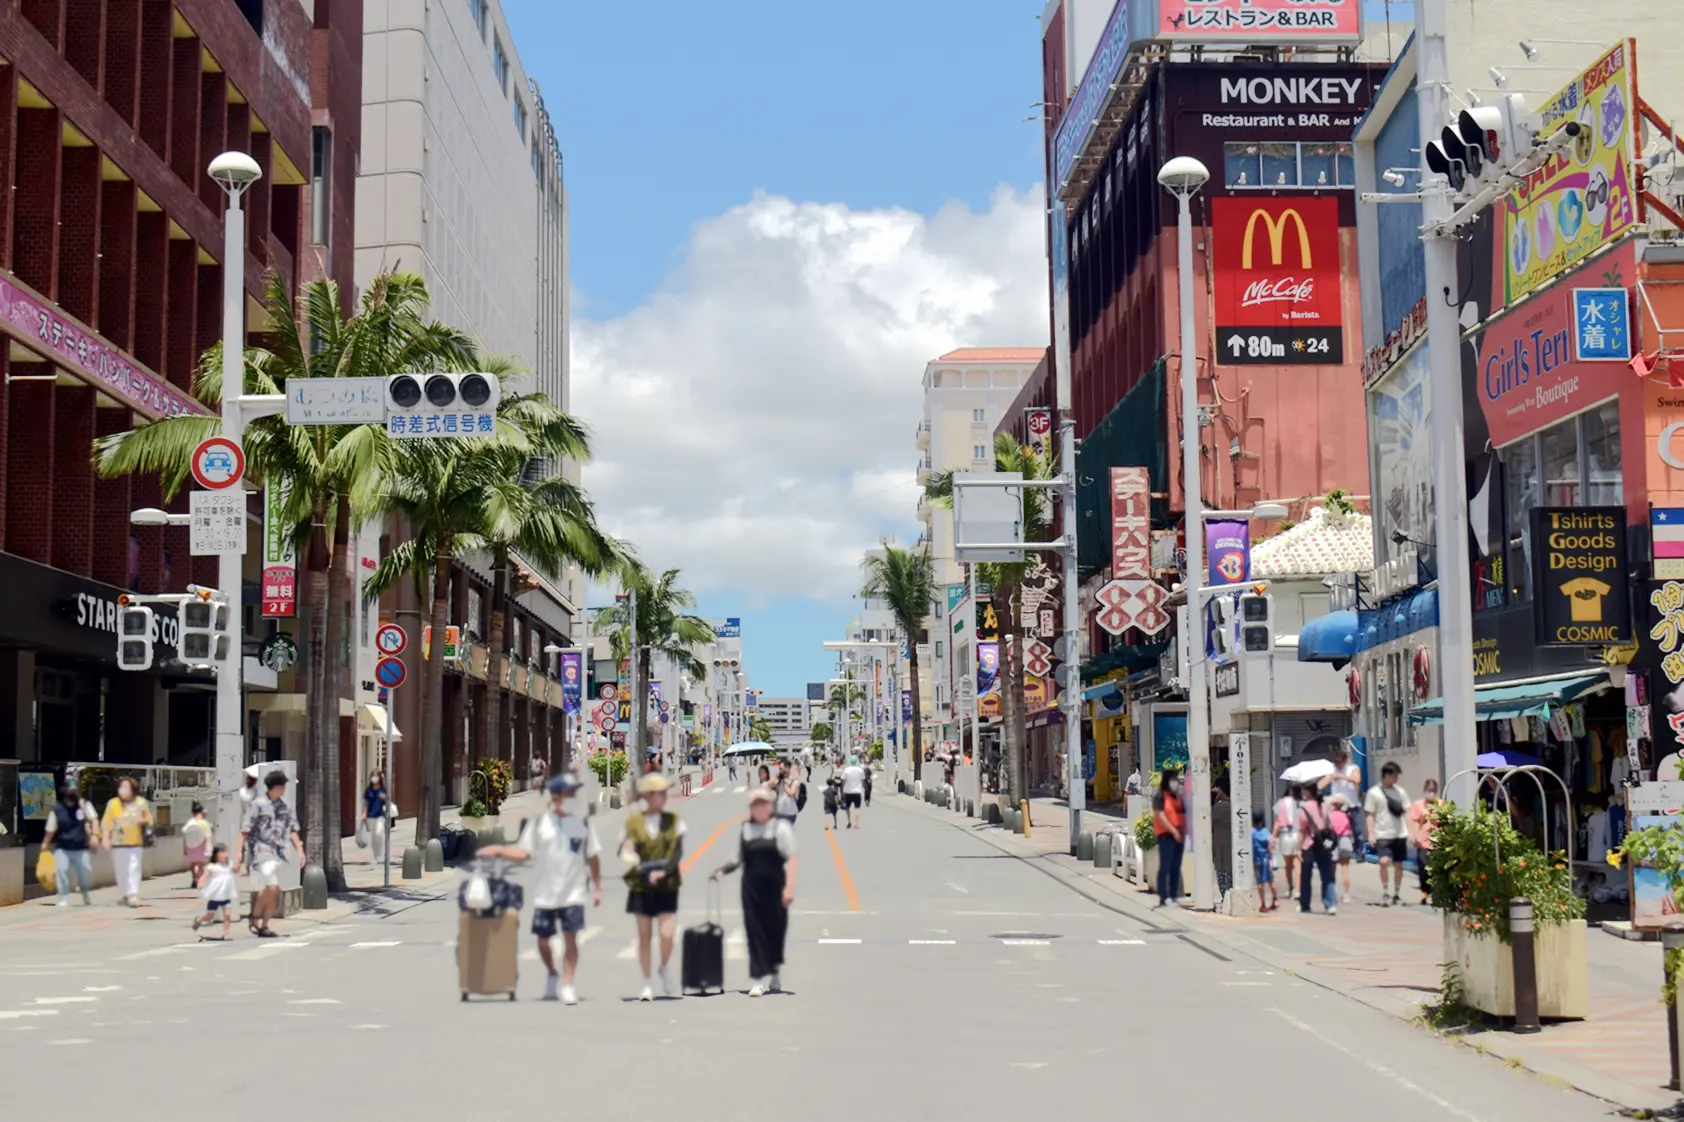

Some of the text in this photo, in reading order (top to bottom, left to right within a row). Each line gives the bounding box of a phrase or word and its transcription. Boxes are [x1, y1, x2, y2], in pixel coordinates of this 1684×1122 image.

[1220, 77, 1363, 105] MONKEY
[1202, 113, 1284, 127] Restaurant
[1287, 118, 1297, 126] &
[1298, 114, 1330, 127] BAR
[1609, 184, 1630, 231] 2F
[1290, 311, 1320, 319] Barista
[1581, 299, 1606, 350] 水着
[1608, 300, 1623, 350] オシャレ
[1247, 335, 1330, 357] 80m 24
[1484, 337, 1530, 401] Girl's
[1535, 376, 1580, 410] Boutique
[391, 414, 493, 434] 時差式信号機
[1029, 416, 1049, 430] 3F
[1114, 468, 1148, 578] ステーキハウス
[1548, 511, 1615, 529] Tshirts
[1549, 532, 1616, 549] Goods
[1550, 552, 1617, 572] Design
[266, 585, 292, 598] 無料
[1099, 584, 1168, 632] 88
[1556, 626, 1619, 641] COSMIC
[1473, 651, 1501, 676] OSMIC
